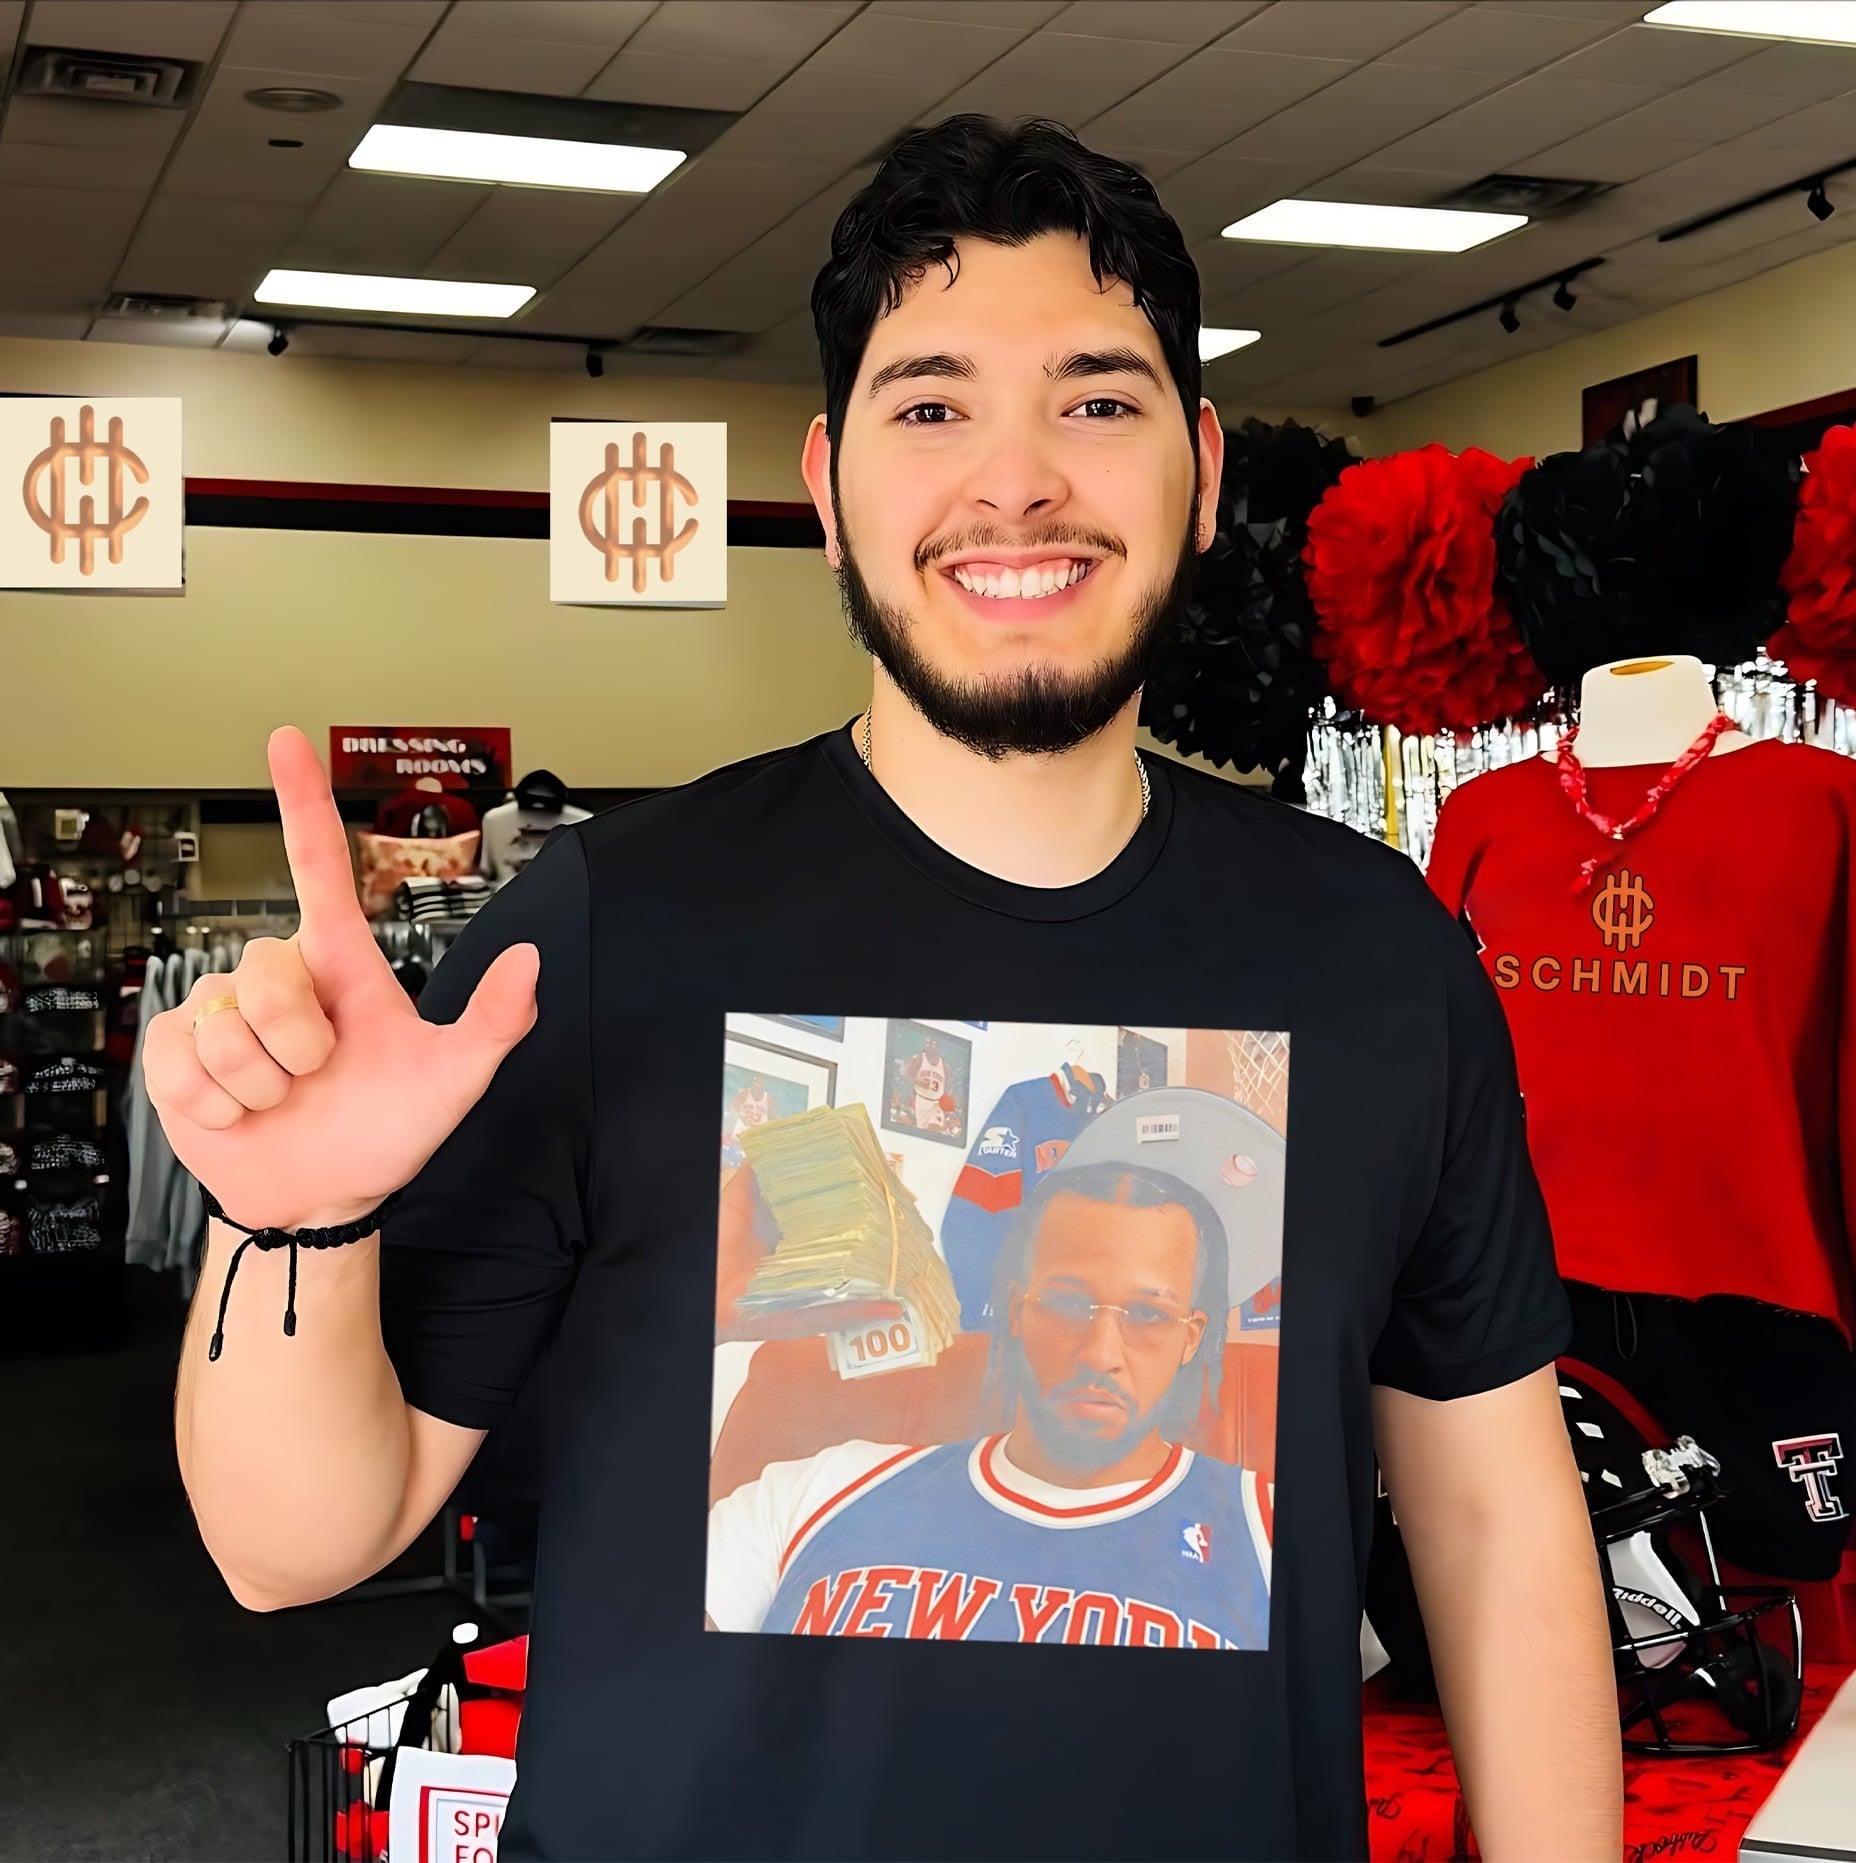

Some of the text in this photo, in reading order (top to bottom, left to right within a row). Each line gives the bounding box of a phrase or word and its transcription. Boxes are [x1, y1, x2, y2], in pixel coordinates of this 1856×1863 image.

[396, 758, 487, 775] ROOMS
[1493, 953, 1747, 1000] SCHMIDT
[848, 1323, 911, 1362] 100
[791, 1565, 1003, 1641] NEW
